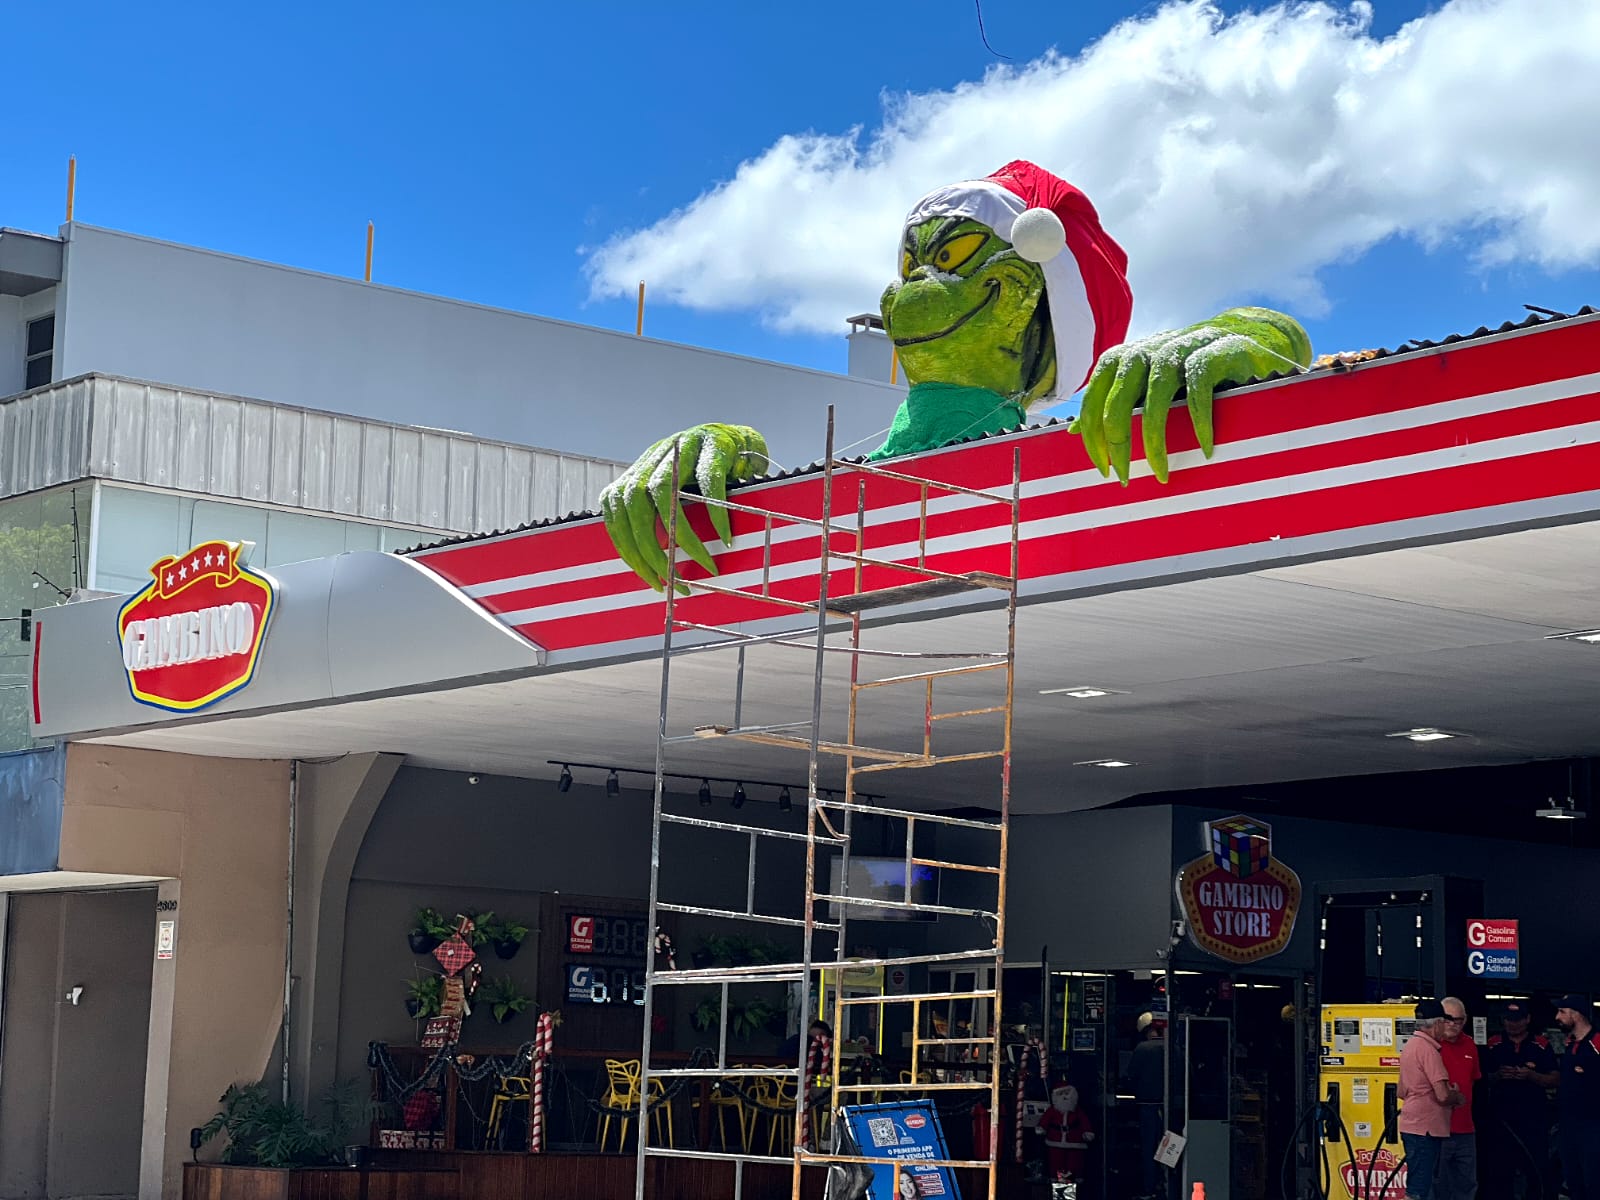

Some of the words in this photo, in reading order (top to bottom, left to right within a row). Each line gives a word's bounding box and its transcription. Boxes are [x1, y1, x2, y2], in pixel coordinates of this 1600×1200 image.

[123, 602, 254, 671] GAMBINO
[1200, 881, 1284, 911] GAMBINO
[573, 917, 591, 937] G
[1213, 910, 1271, 937] STORE
[1468, 922, 1486, 946] G
[1486, 926, 1516, 935] Gasolina
[1488, 934, 1514, 943] Comum
[1468, 951, 1485, 975] G
[1486, 956, 1516, 965] Gasolina
[572, 967, 590, 987] G
